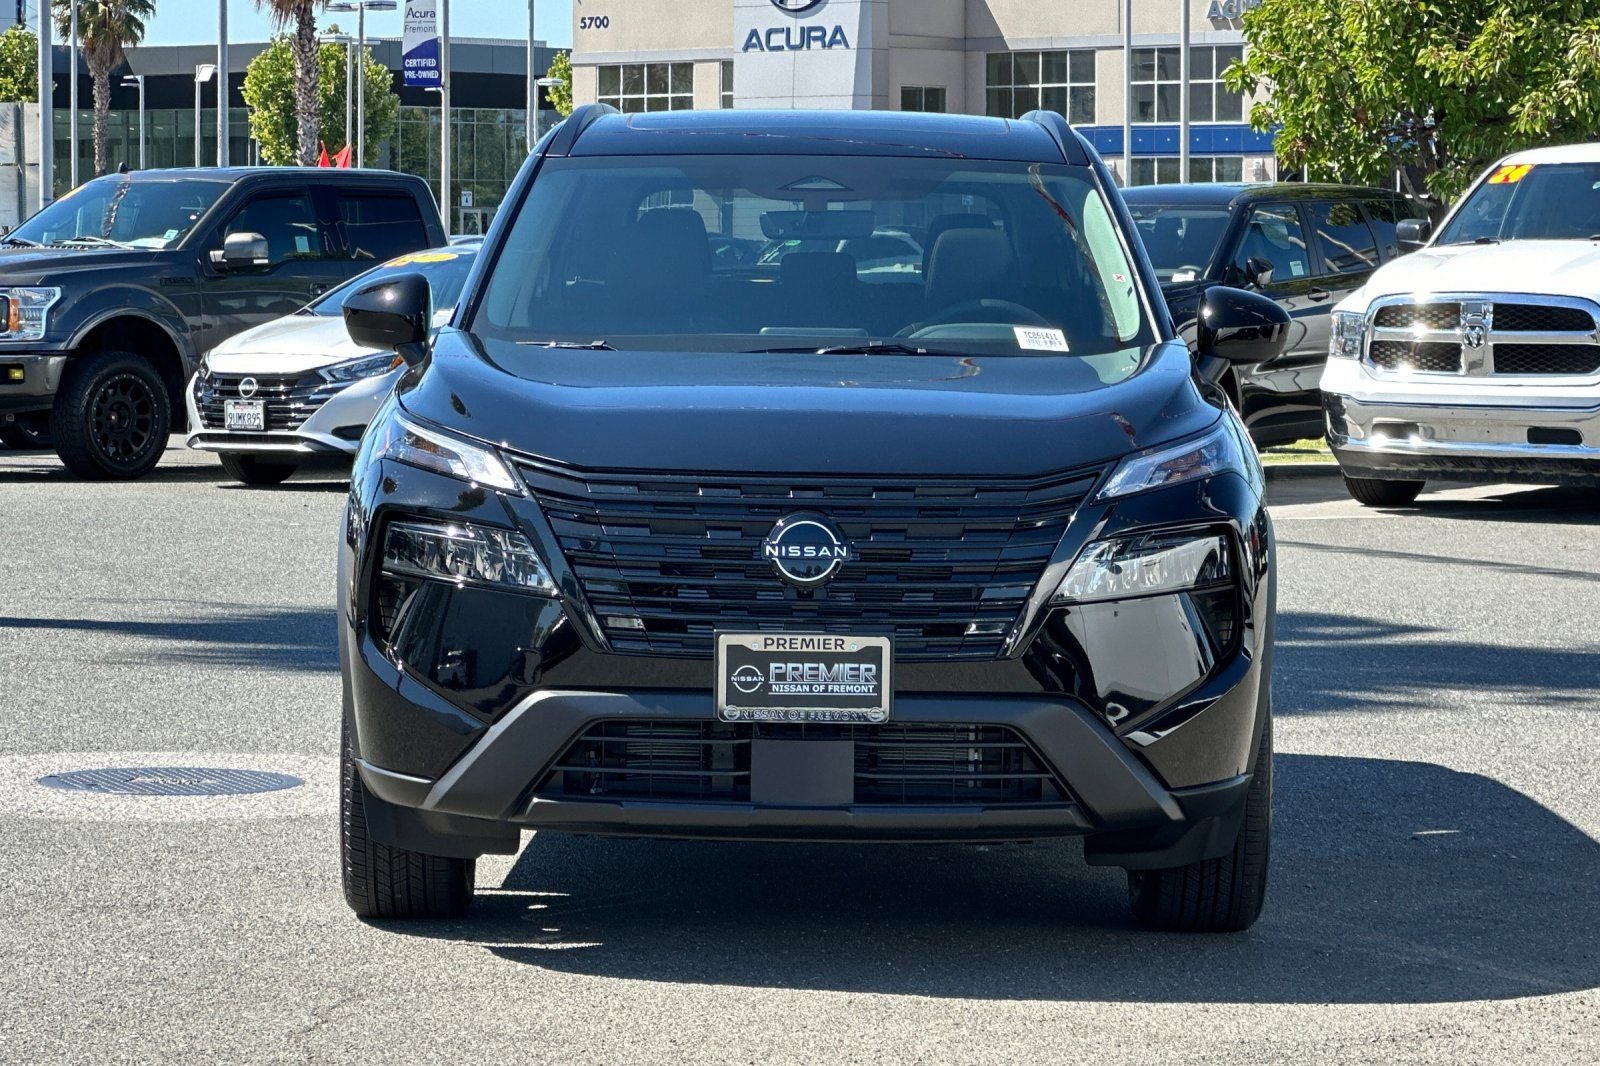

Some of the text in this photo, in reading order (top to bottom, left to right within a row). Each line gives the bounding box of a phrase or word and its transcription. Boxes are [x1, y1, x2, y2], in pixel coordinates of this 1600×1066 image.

[406, 7, 436, 19] Acura
[580, 16, 610, 29] 5700
[404, 25, 436, 33] Fremont
[742, 25, 850, 53] ACURA
[404, 58, 437, 67] CERTIFIED
[404, 70, 439, 79] PRE-OWNED
[765, 545, 847, 557] NISSAN
[763, 637, 845, 650] PREMIER
[769, 662, 877, 684] PREMIER
[772, 684, 875, 693] NISSAN OF FREMONT
[741, 709, 785, 720] NISSAN
